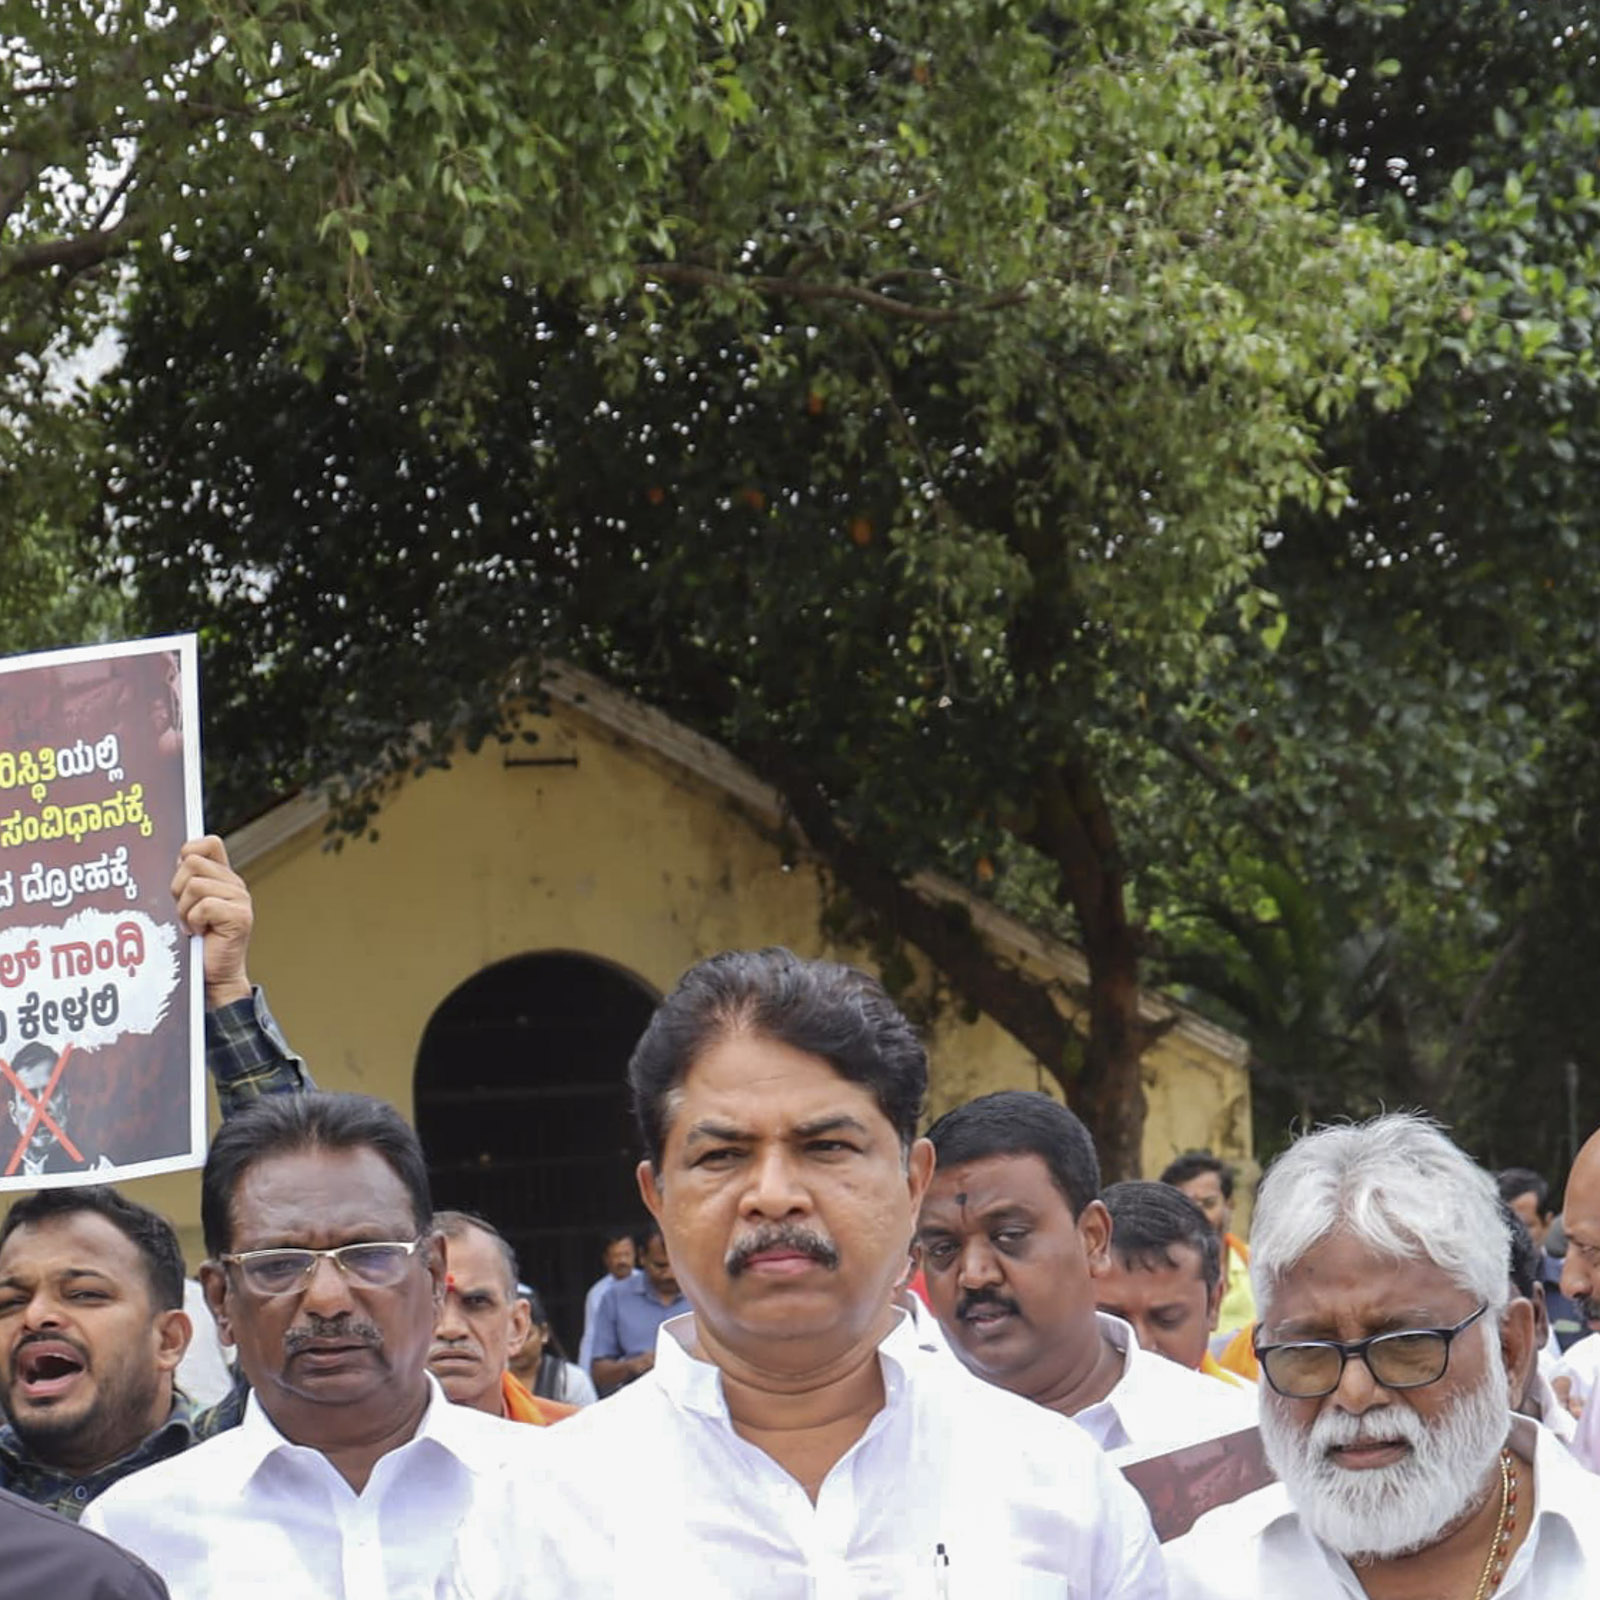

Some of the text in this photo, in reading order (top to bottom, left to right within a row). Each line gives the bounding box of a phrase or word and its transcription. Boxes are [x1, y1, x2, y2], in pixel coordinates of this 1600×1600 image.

[0, 783, 153, 848] ಸಂವಿಧಾನಕ್ಕೆ
[21, 846, 137, 907] ದ್ರೋಹಕ್ಕೆ
[50, 921, 144, 978] ಗಾಂಧಿ
[18, 982, 119, 1039] ಕೇಳಲಿ
